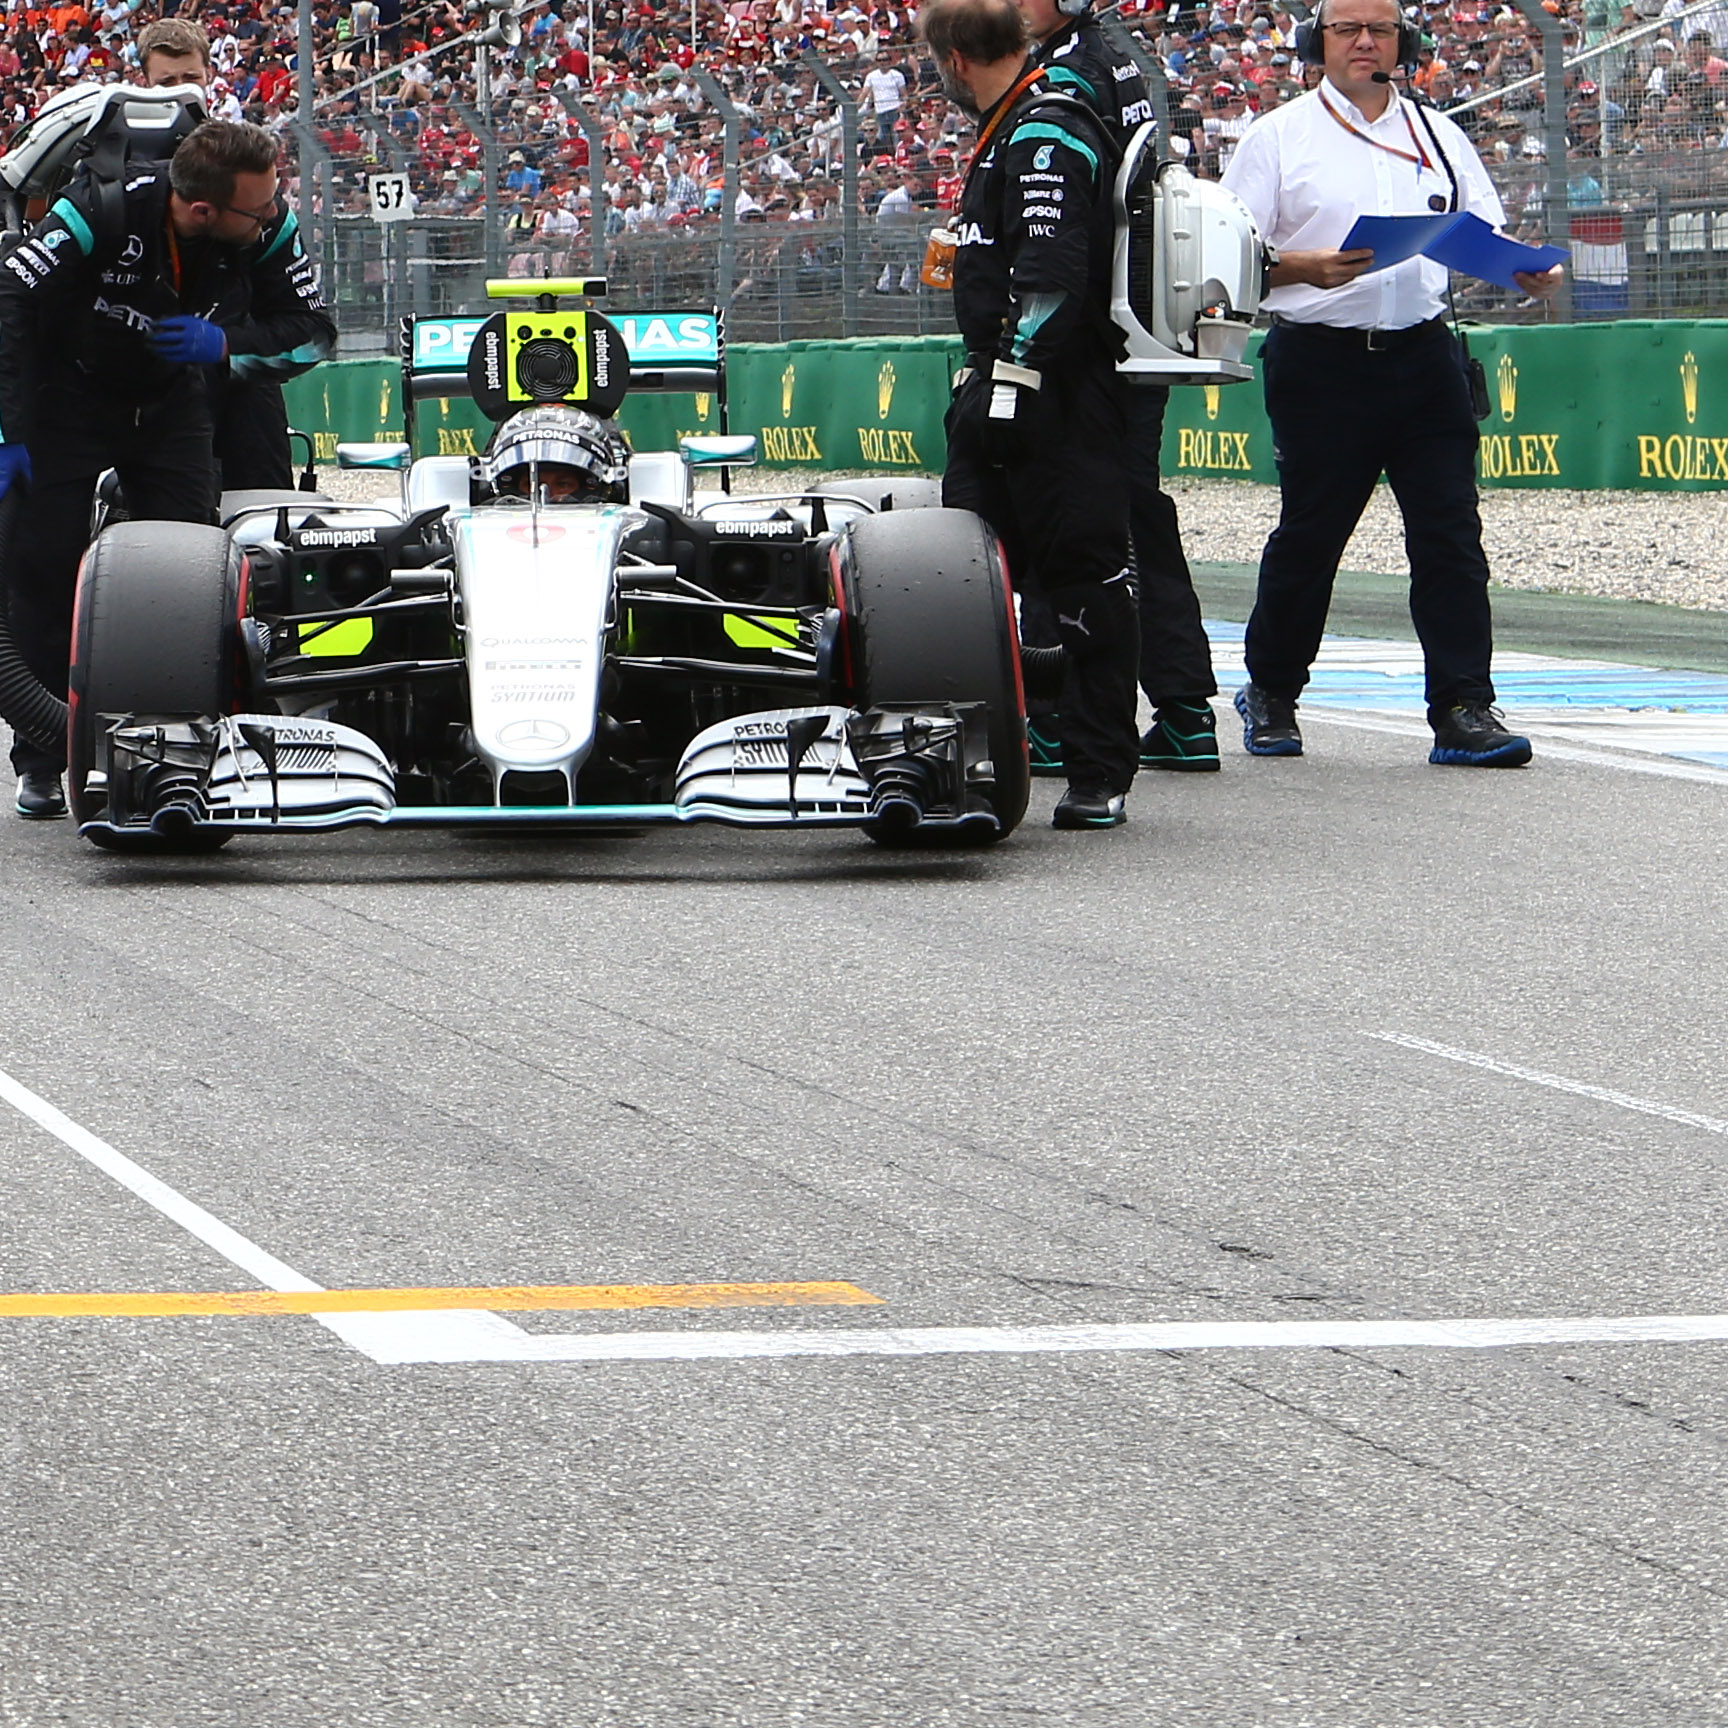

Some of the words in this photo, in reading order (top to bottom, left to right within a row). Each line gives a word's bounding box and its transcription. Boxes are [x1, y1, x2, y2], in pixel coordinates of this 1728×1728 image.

[1019, 173, 1065, 184] PETRONAS
[375, 179, 404, 209] 57
[1022, 204, 1062, 220] EPSON
[1028, 224, 1055, 238] IWC
[4, 256, 39, 289] EPSON
[484, 331, 502, 391] ebmpapst
[593, 328, 610, 388] ebmpapst
[512, 429, 580, 445] PETRONAS
[761, 426, 823, 461] ROLEX
[857, 427, 922, 464] ROLEX
[1178, 428, 1252, 471] ROLEX
[1480, 433, 1561, 478] ROLEX
[1638, 433, 1728, 481] ROLEX
[300, 527, 376, 548] ebmpapst
[715, 520, 793, 537] ebmpapst
[491, 690, 576, 703] SYNTIUM
[276, 728, 335, 743] TRONAS
[734, 721, 788, 738] PETRO
